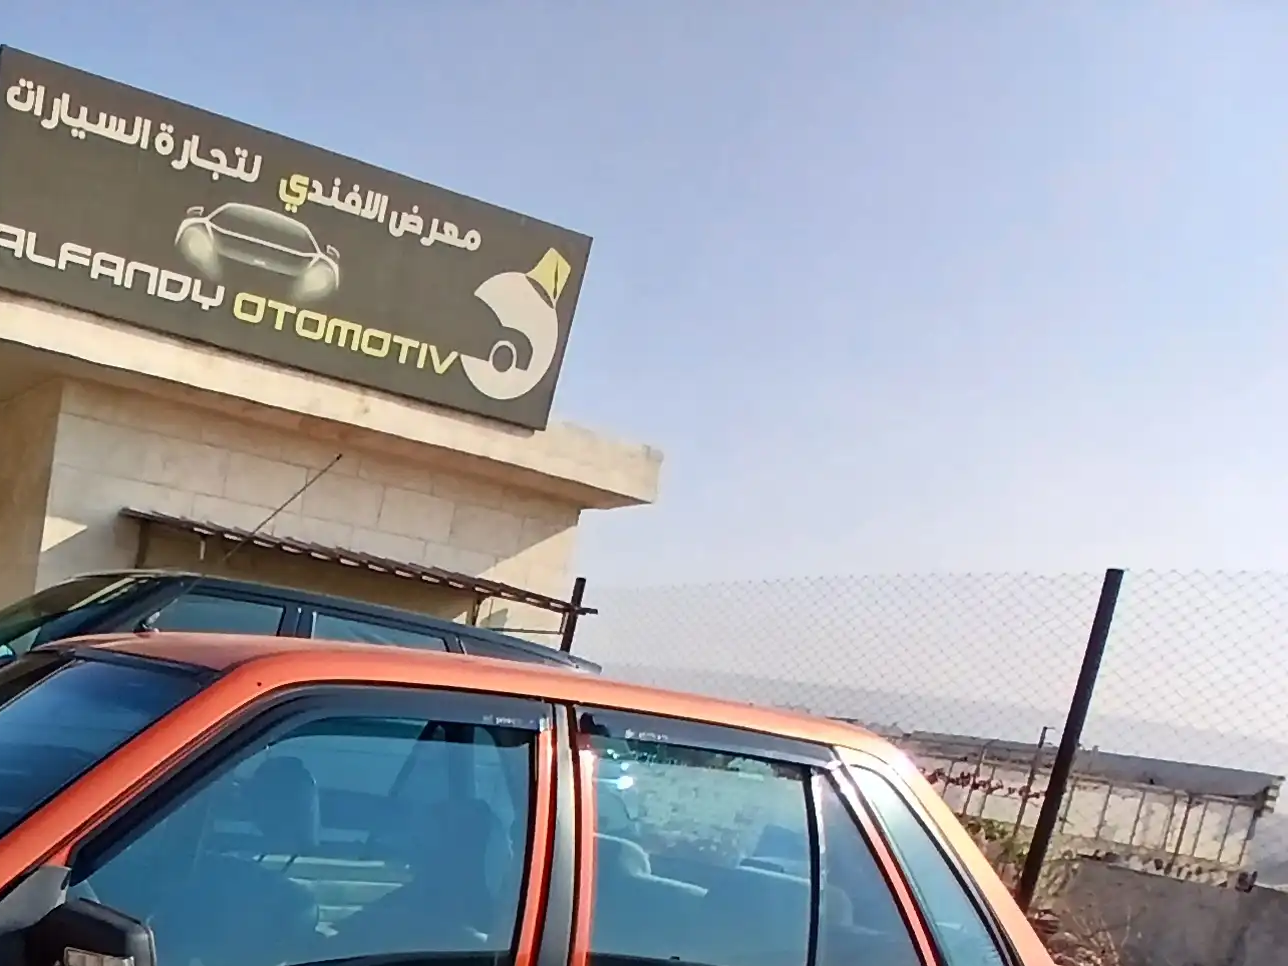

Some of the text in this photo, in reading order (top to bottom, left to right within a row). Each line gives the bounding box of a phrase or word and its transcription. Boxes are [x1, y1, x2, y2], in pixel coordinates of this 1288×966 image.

[6, 78, 152, 149] السيارات
[154, 122, 263, 183] لتجارة
[389, 204, 482, 251] معرض
[233, 292, 459, 375] OTOMOTIV
